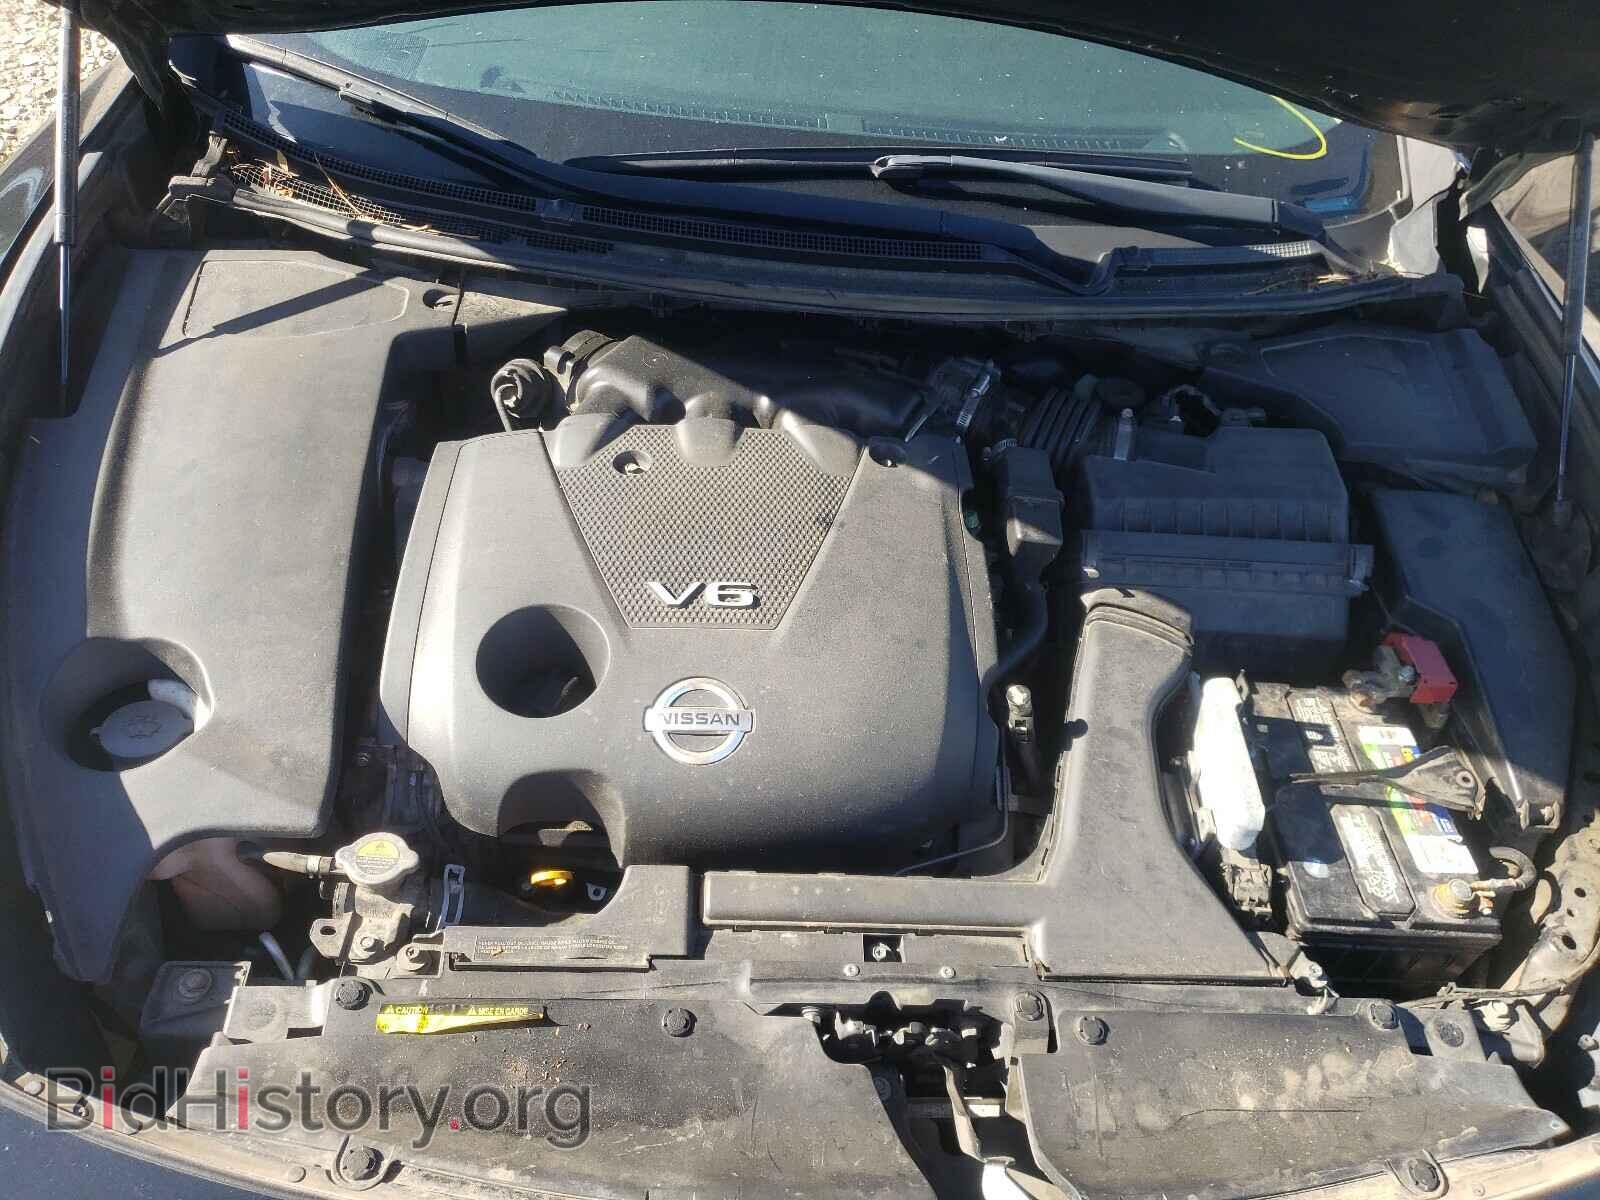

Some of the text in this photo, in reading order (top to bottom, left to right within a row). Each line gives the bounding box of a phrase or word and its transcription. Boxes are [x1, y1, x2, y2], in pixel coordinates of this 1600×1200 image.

[648, 581, 761, 608] V6
[659, 712, 740, 726] NISSAN
[395, 1006, 429, 1015] CAUTION
